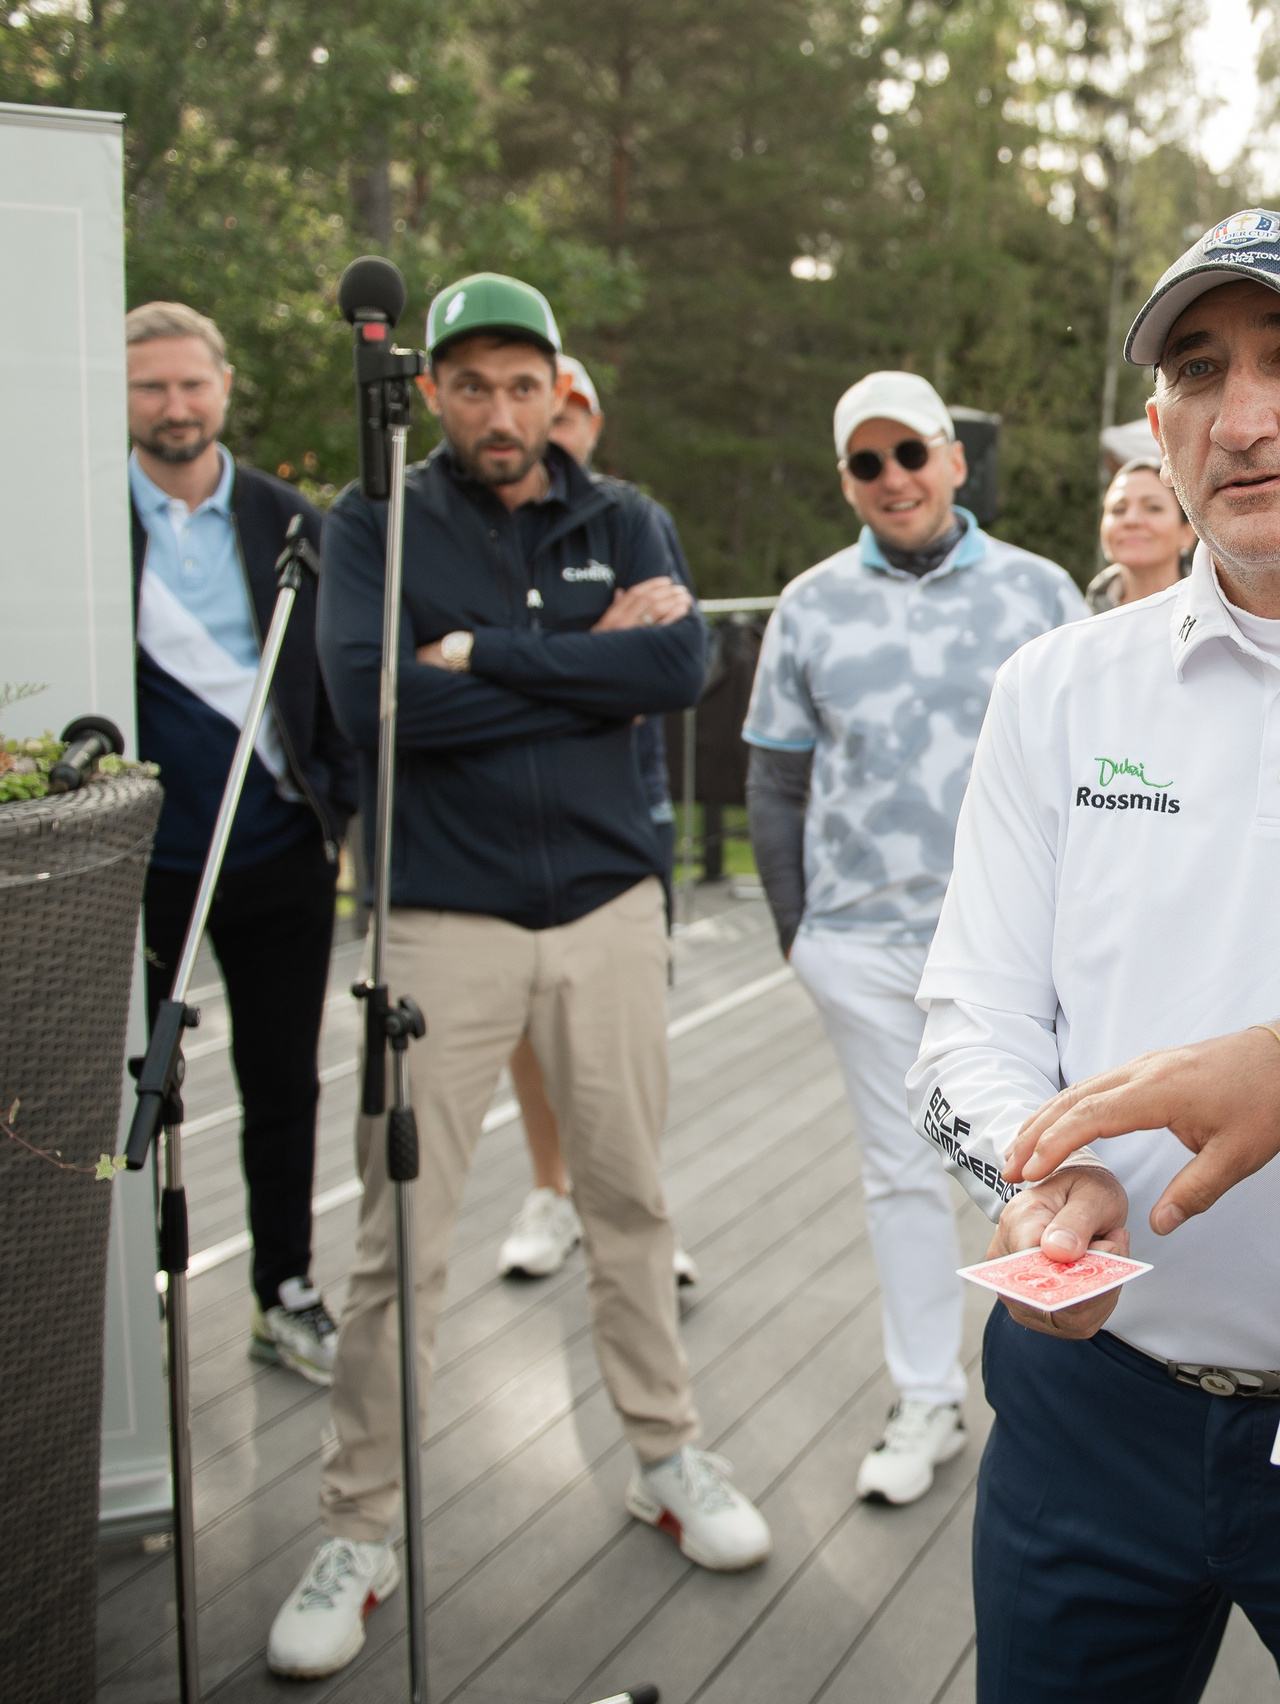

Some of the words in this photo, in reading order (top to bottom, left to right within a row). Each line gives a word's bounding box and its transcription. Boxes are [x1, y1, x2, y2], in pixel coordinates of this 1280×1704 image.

[1249, 230, 1273, 238] CUP
[1094, 757, 1173, 788] Dubai
[1076, 786, 1180, 814] Rossmils
[929, 1086, 971, 1137] GOLF
[924, 1109, 1022, 1204] COMPRESSIO
